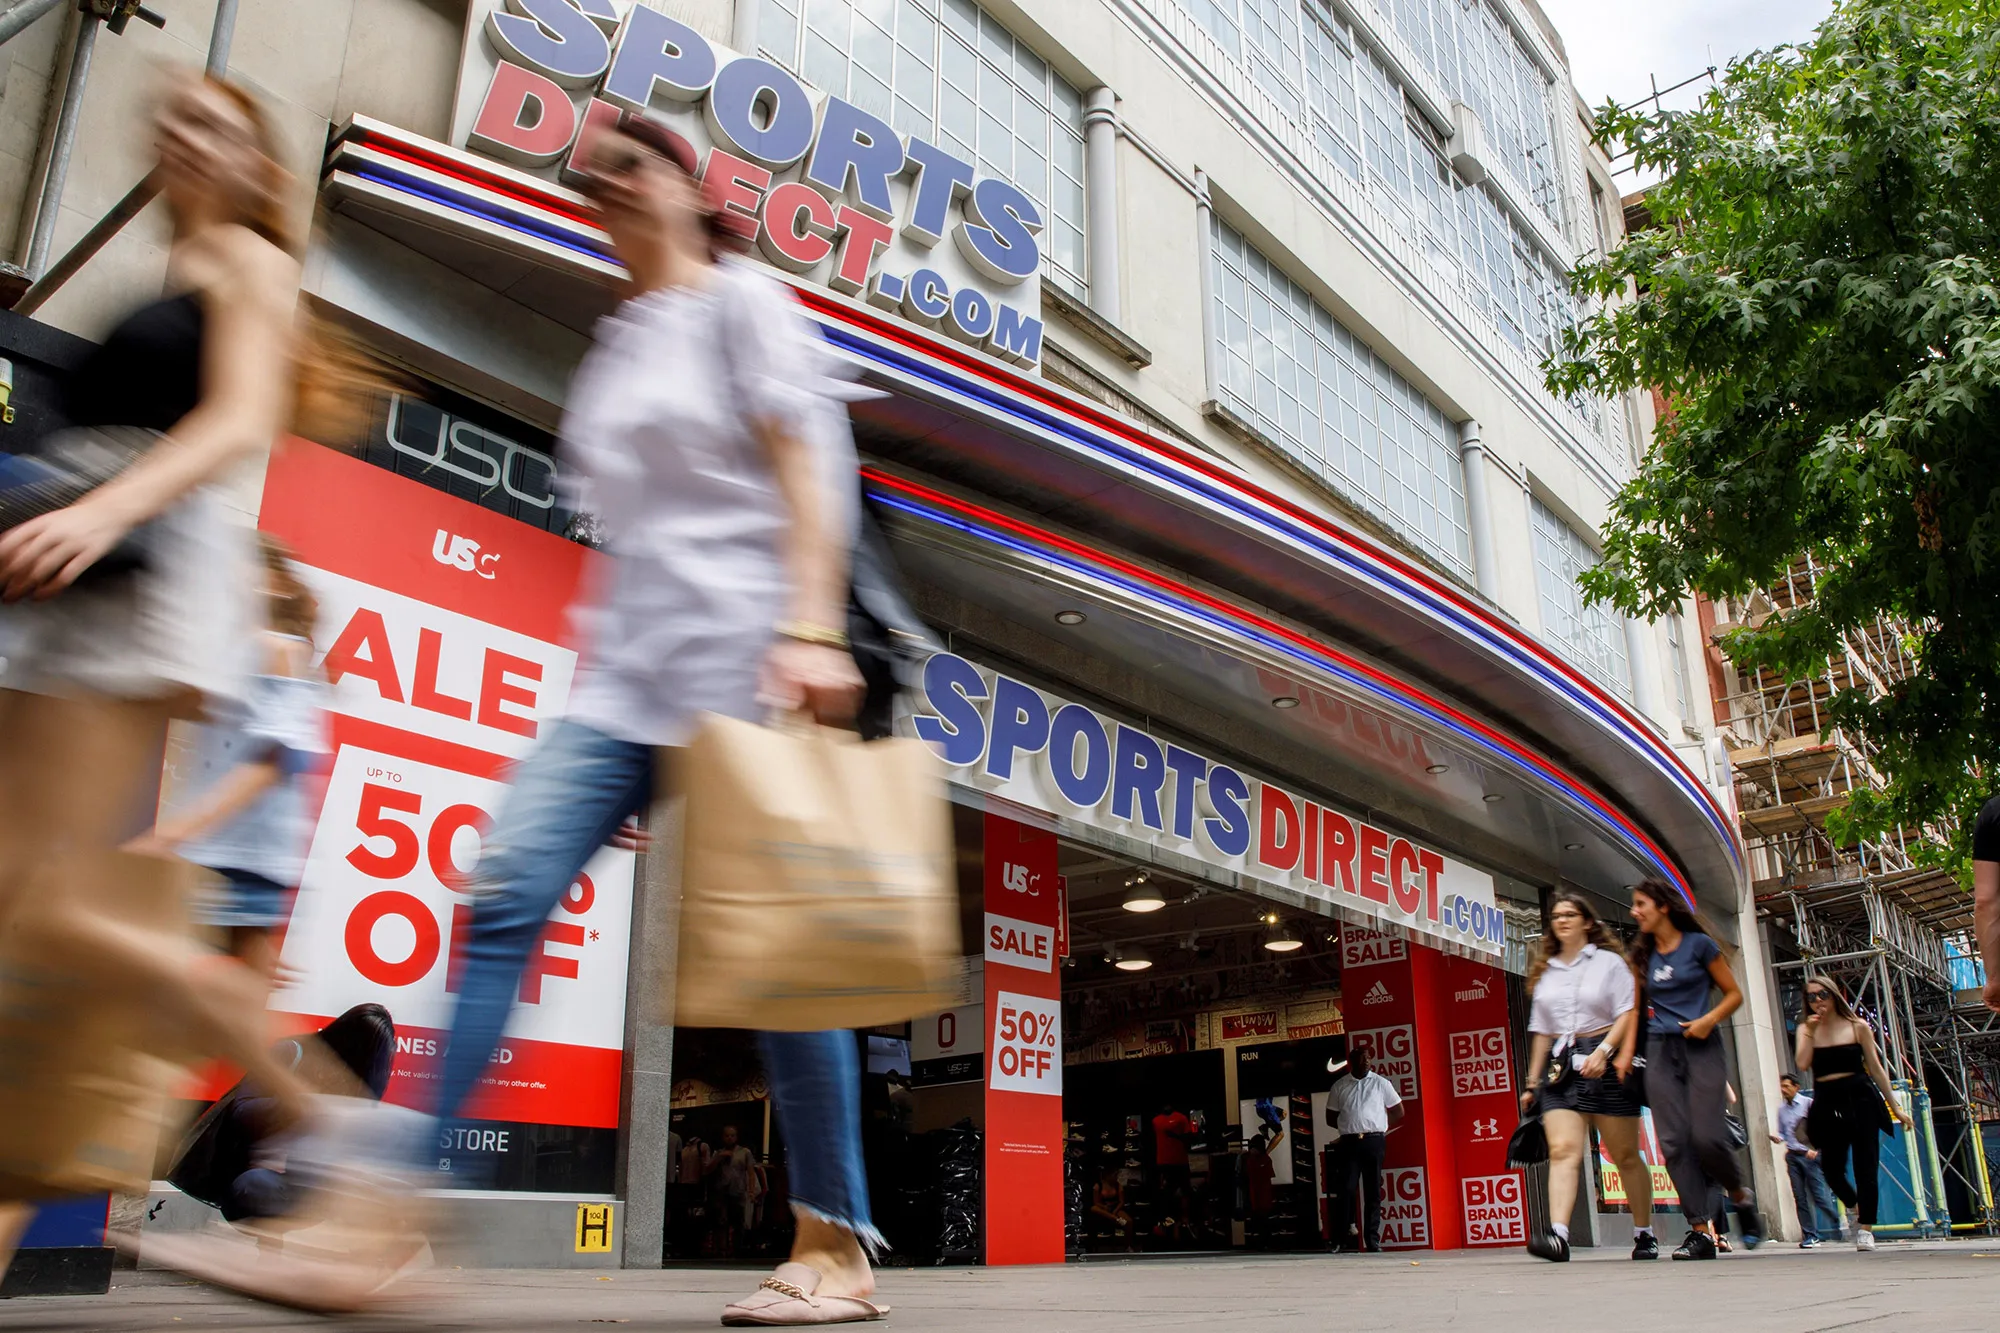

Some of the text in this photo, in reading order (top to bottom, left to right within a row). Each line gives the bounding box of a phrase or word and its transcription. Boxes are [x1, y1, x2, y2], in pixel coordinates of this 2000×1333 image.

[486, 0, 1043, 282] SPORTS
[472, 60, 893, 286] DIECT
[386, 392, 558, 509] USC
[432, 528, 500, 579] USC
[316, 606, 543, 739] ALE
[367, 766, 402, 783] UP TO
[345, 782, 596, 915] 50
[1003, 861, 1041, 896] USC
[989, 925, 1048, 960] SALE
[1346, 939, 1403, 965] SALE
[1362, 995, 1394, 1005] adidas
[1455, 988, 1485, 1002] PUMA
[999, 1007, 1056, 1048] 50%
[395, 1036, 437, 1057] NES
[1241, 1052, 1259, 1061] RUN
[1452, 1031, 1504, 1061] BIG
[1371, 1061, 1412, 1077] AND
[1454, 1058, 1505, 1076] BRAND
[497, 1079, 510, 1088] any
[511, 1080, 529, 1088] other
[530, 1081, 547, 1090] offer.
[1456, 1073, 1508, 1094] SALE
[440, 1129, 509, 1152] STORE
[1466, 1177, 1519, 1207] BIG
[1380, 1204, 1423, 1221] RAND
[1468, 1206, 1519, 1222] BRAND
[581, 1208, 608, 1247] H
[1378, 1222, 1426, 1244] ALE
[1469, 1222, 1523, 1242] SALE
